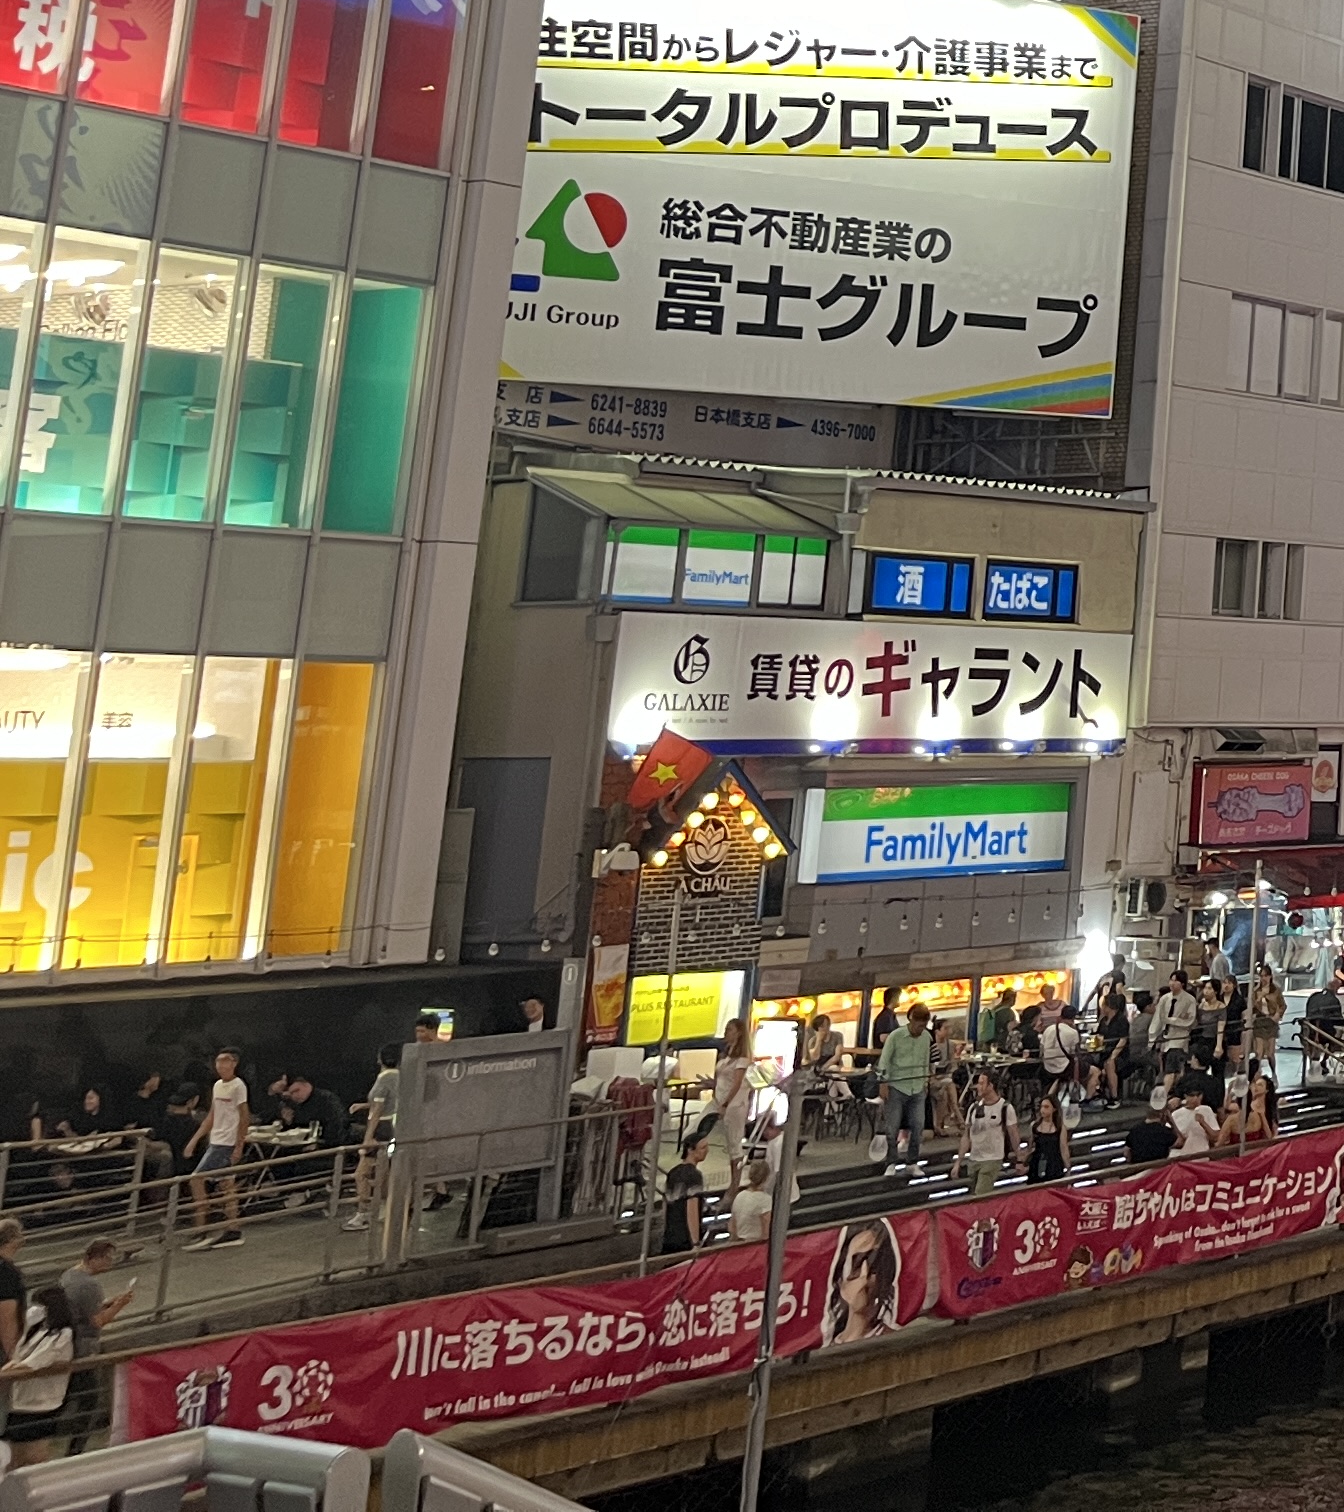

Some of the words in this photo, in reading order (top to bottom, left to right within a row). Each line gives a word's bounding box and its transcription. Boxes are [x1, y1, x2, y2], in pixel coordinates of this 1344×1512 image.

[529, 82, 1098, 158] トータルプロデュース
[659, 197, 952, 264] 総合不動産業の
[546, 304, 620, 330] Group
[654, 257, 1098, 360] 富士グループ
[590, 393, 668, 419] 6241-8839
[695, 405, 772, 430] 日本橋支店
[810, 419, 876, 442] 4396-7000
[588, 417, 665, 442] 6644-5573
[683, 567, 750, 587] FamilyMart
[896, 565, 924, 606] 酒
[988, 572, 1050, 609] たばこ
[746, 639, 1102, 720] 賃貸のギャラント
[864, 820, 1029, 865] FamilyMart
